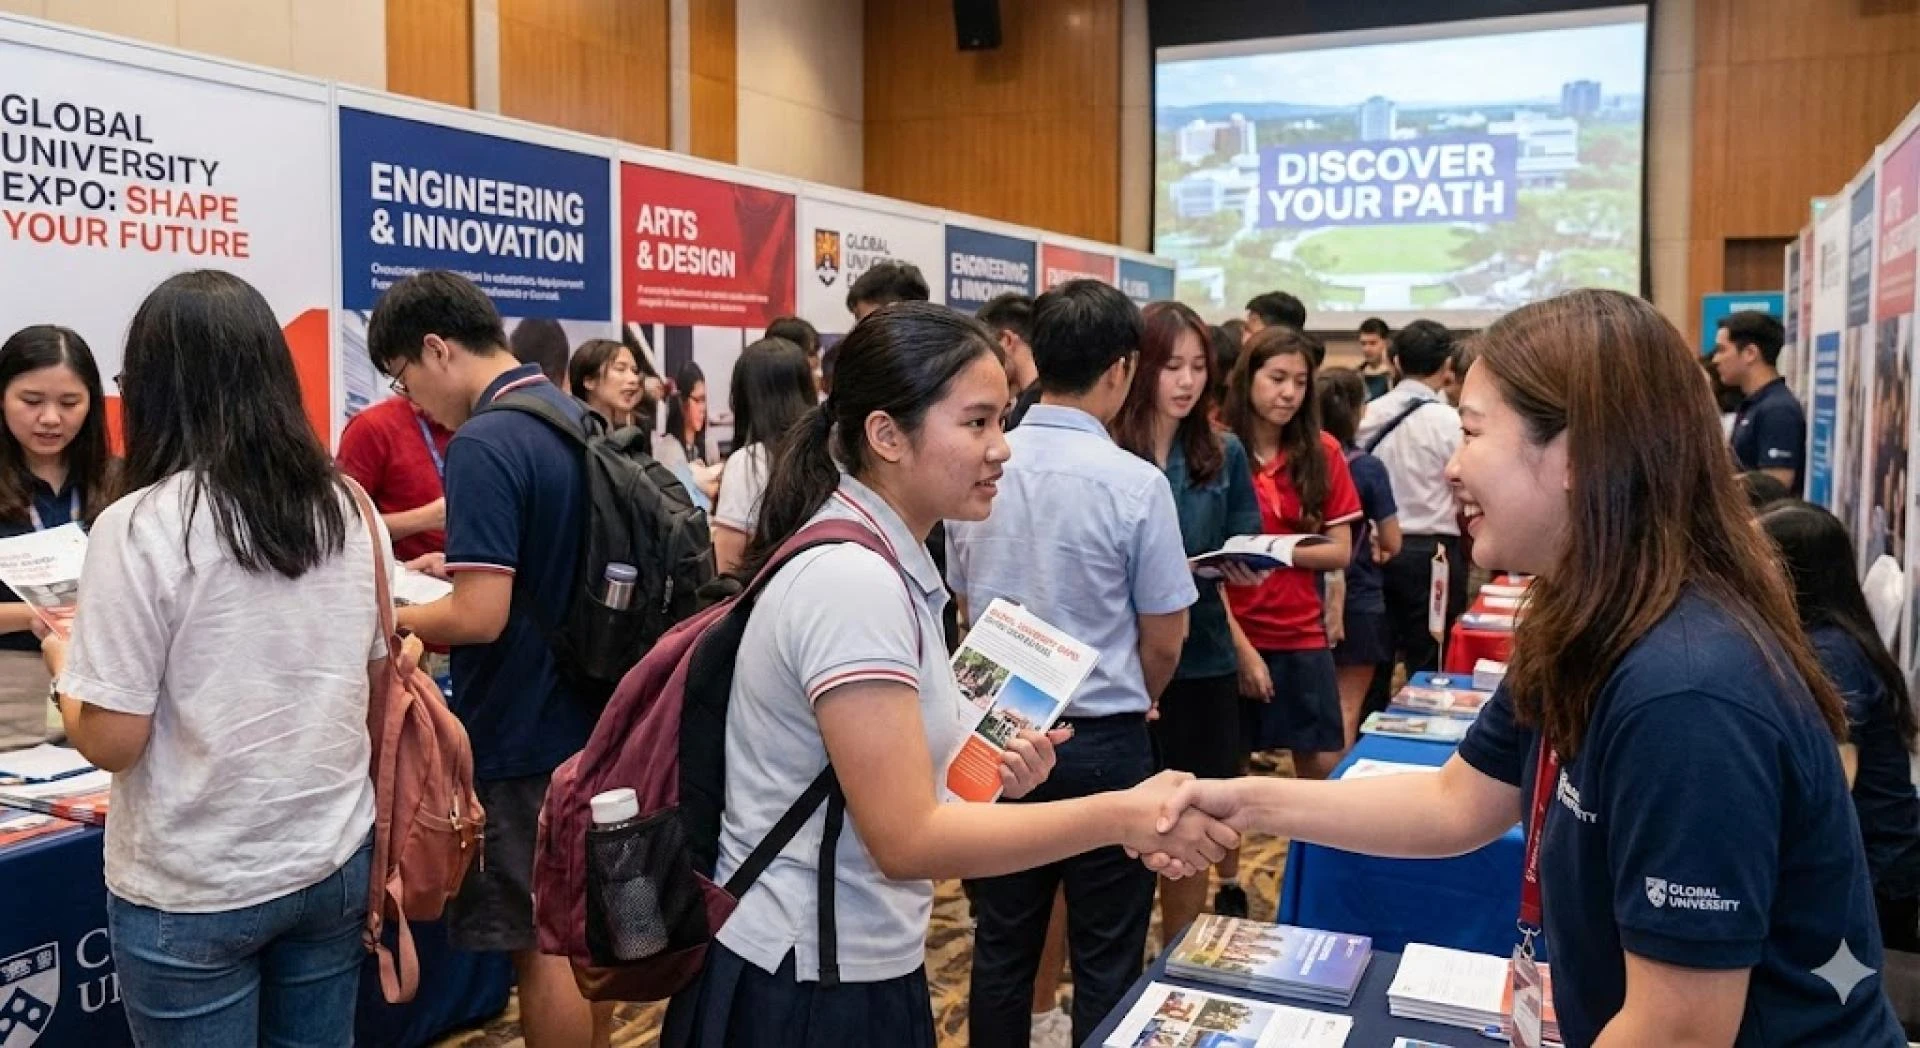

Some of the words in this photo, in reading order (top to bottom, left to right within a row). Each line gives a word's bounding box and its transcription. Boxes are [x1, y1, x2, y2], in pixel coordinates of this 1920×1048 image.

[1, 94, 153, 144] GLOBAL
[1, 132, 219, 186] UNIVERSITY
[1278, 143, 1495, 185] DISCOVER
[3, 171, 116, 211] EXPO:
[126, 185, 239, 223] SHAPE
[371, 161, 584, 226] ENGINEERING
[1267, 185, 1382, 222] YOUR
[1392, 180, 1504, 217] PATH
[3, 209, 108, 248] YOUR
[120, 220, 250, 258] FUTURE
[370, 208, 395, 245] &
[402, 211, 584, 264] INNOVATION
[636, 203, 698, 241] ARTS
[637, 240, 653, 271] &
[657, 242, 736, 279] DESIGN
